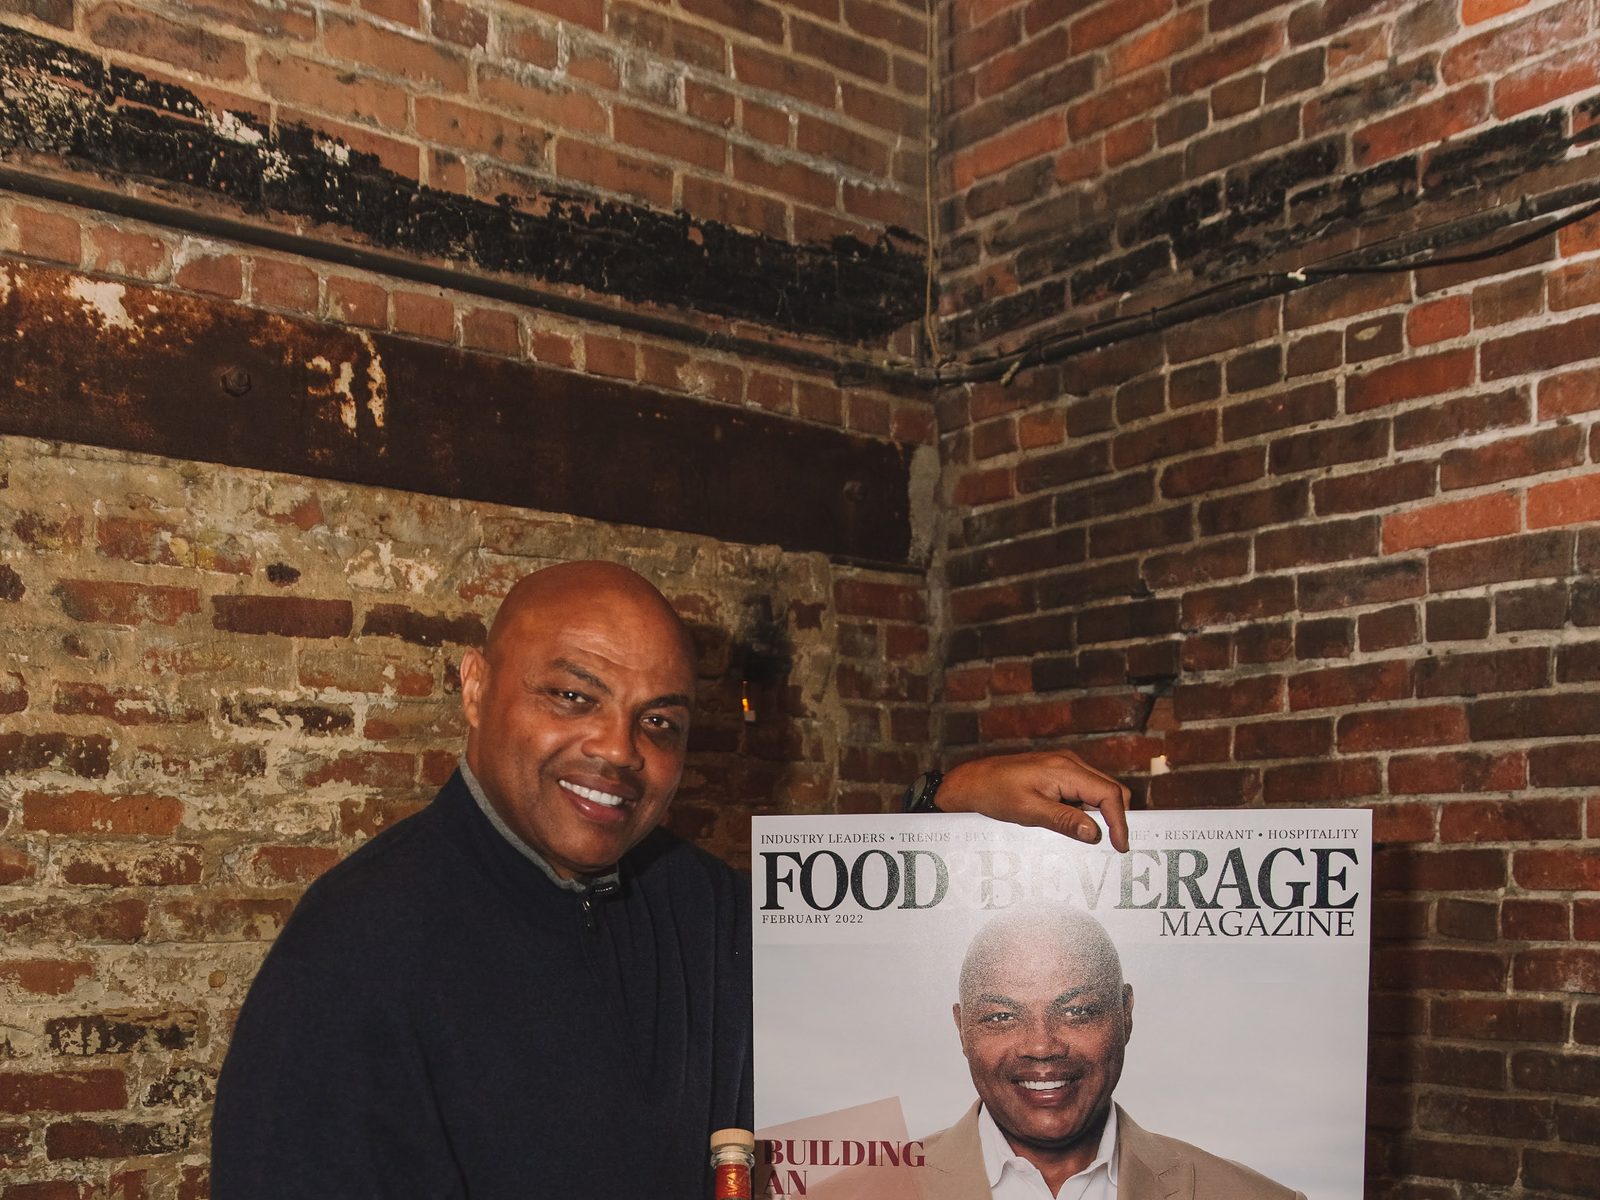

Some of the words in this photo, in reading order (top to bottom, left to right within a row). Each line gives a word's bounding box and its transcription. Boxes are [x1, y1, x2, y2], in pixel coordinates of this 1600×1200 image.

[760, 834, 824, 844] INDUSTRY
[828, 833, 885, 843] LEADERS
[899, 832, 951, 843] TRENDS
[1165, 829, 1253, 840] RESTAURANT
[1268, 828, 1359, 840] HOSPITALITY
[760, 849, 949, 910] FOOD
[976, 847, 1359, 910] BVERAGE
[762, 914, 830, 924] FEBRUARY
[835, 914, 863, 924] 2022
[1160, 910, 1355, 937] MAGAZINE
[763, 1139, 925, 1167] BUILDING
[763, 1170, 807, 1196] AN
